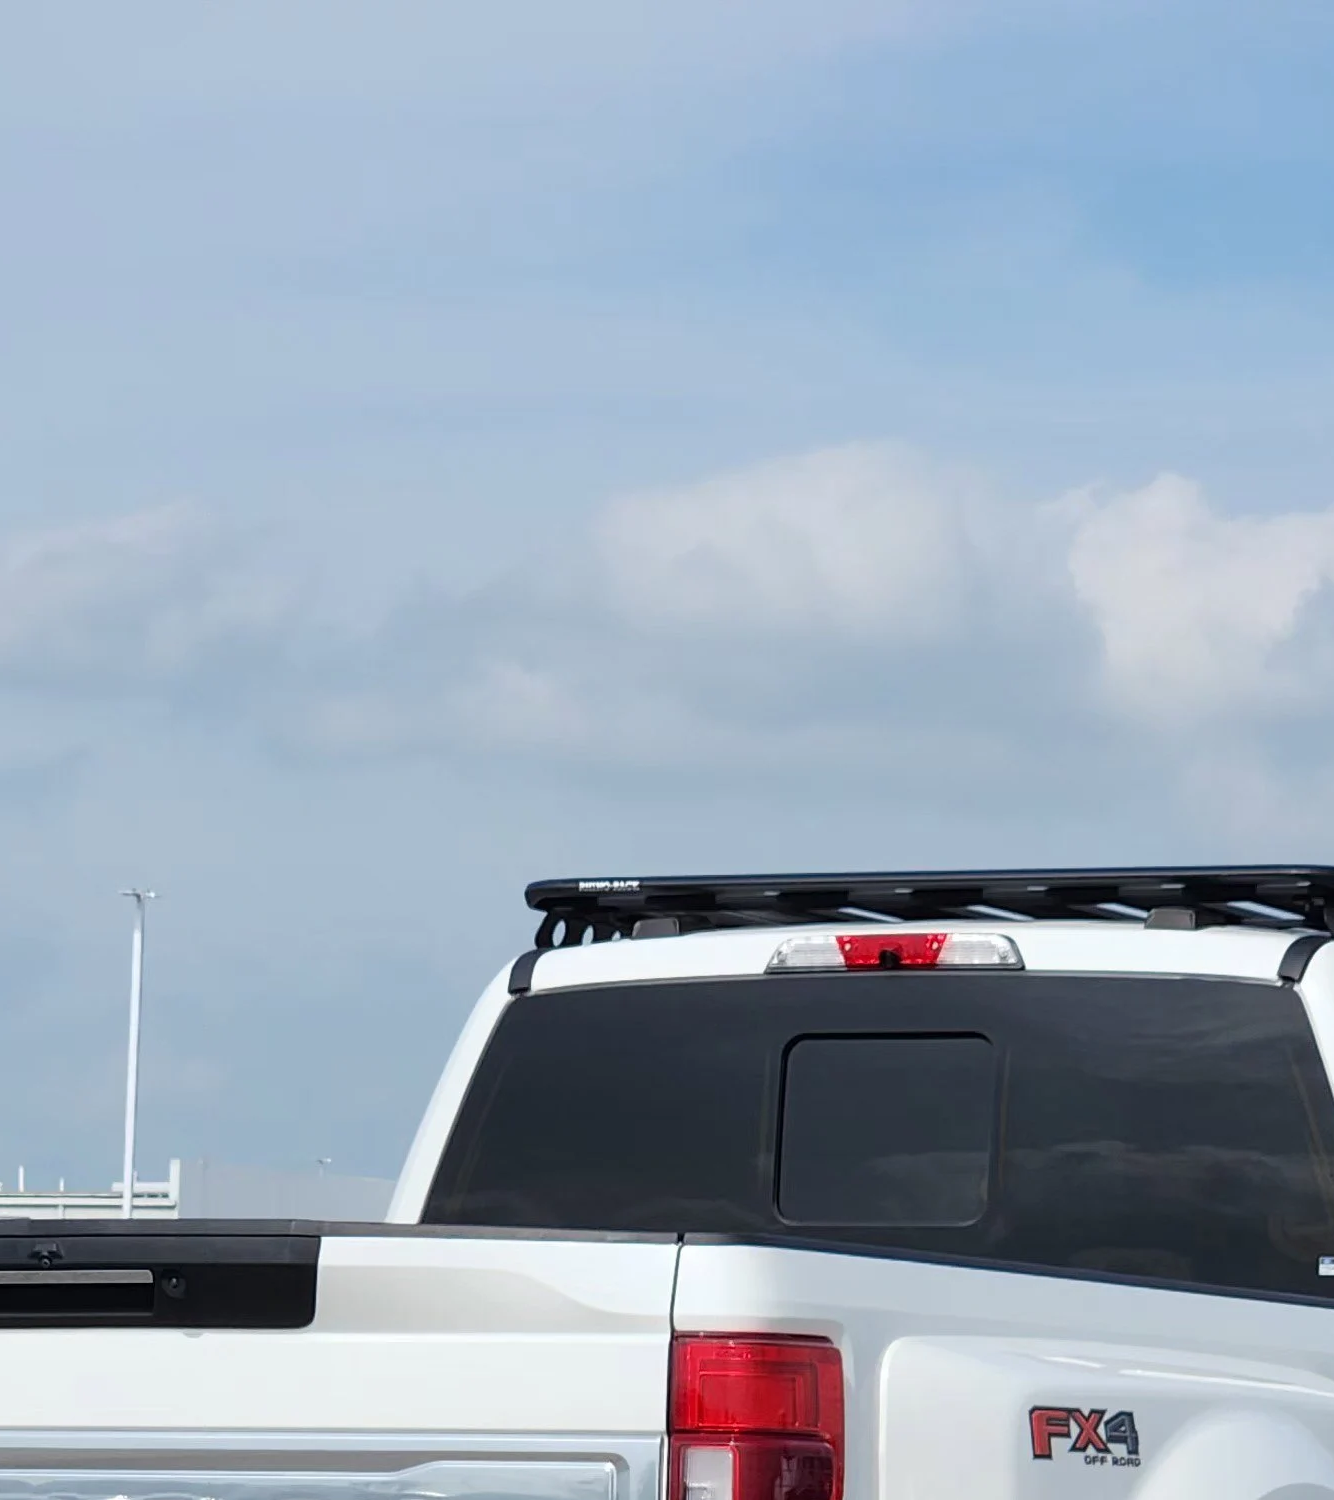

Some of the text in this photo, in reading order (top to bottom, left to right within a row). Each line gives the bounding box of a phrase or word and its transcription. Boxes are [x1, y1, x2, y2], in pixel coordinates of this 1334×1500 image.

[1028, 1405, 1139, 1460] FX4
[1084, 1455, 1142, 1468] OFF ROAD
